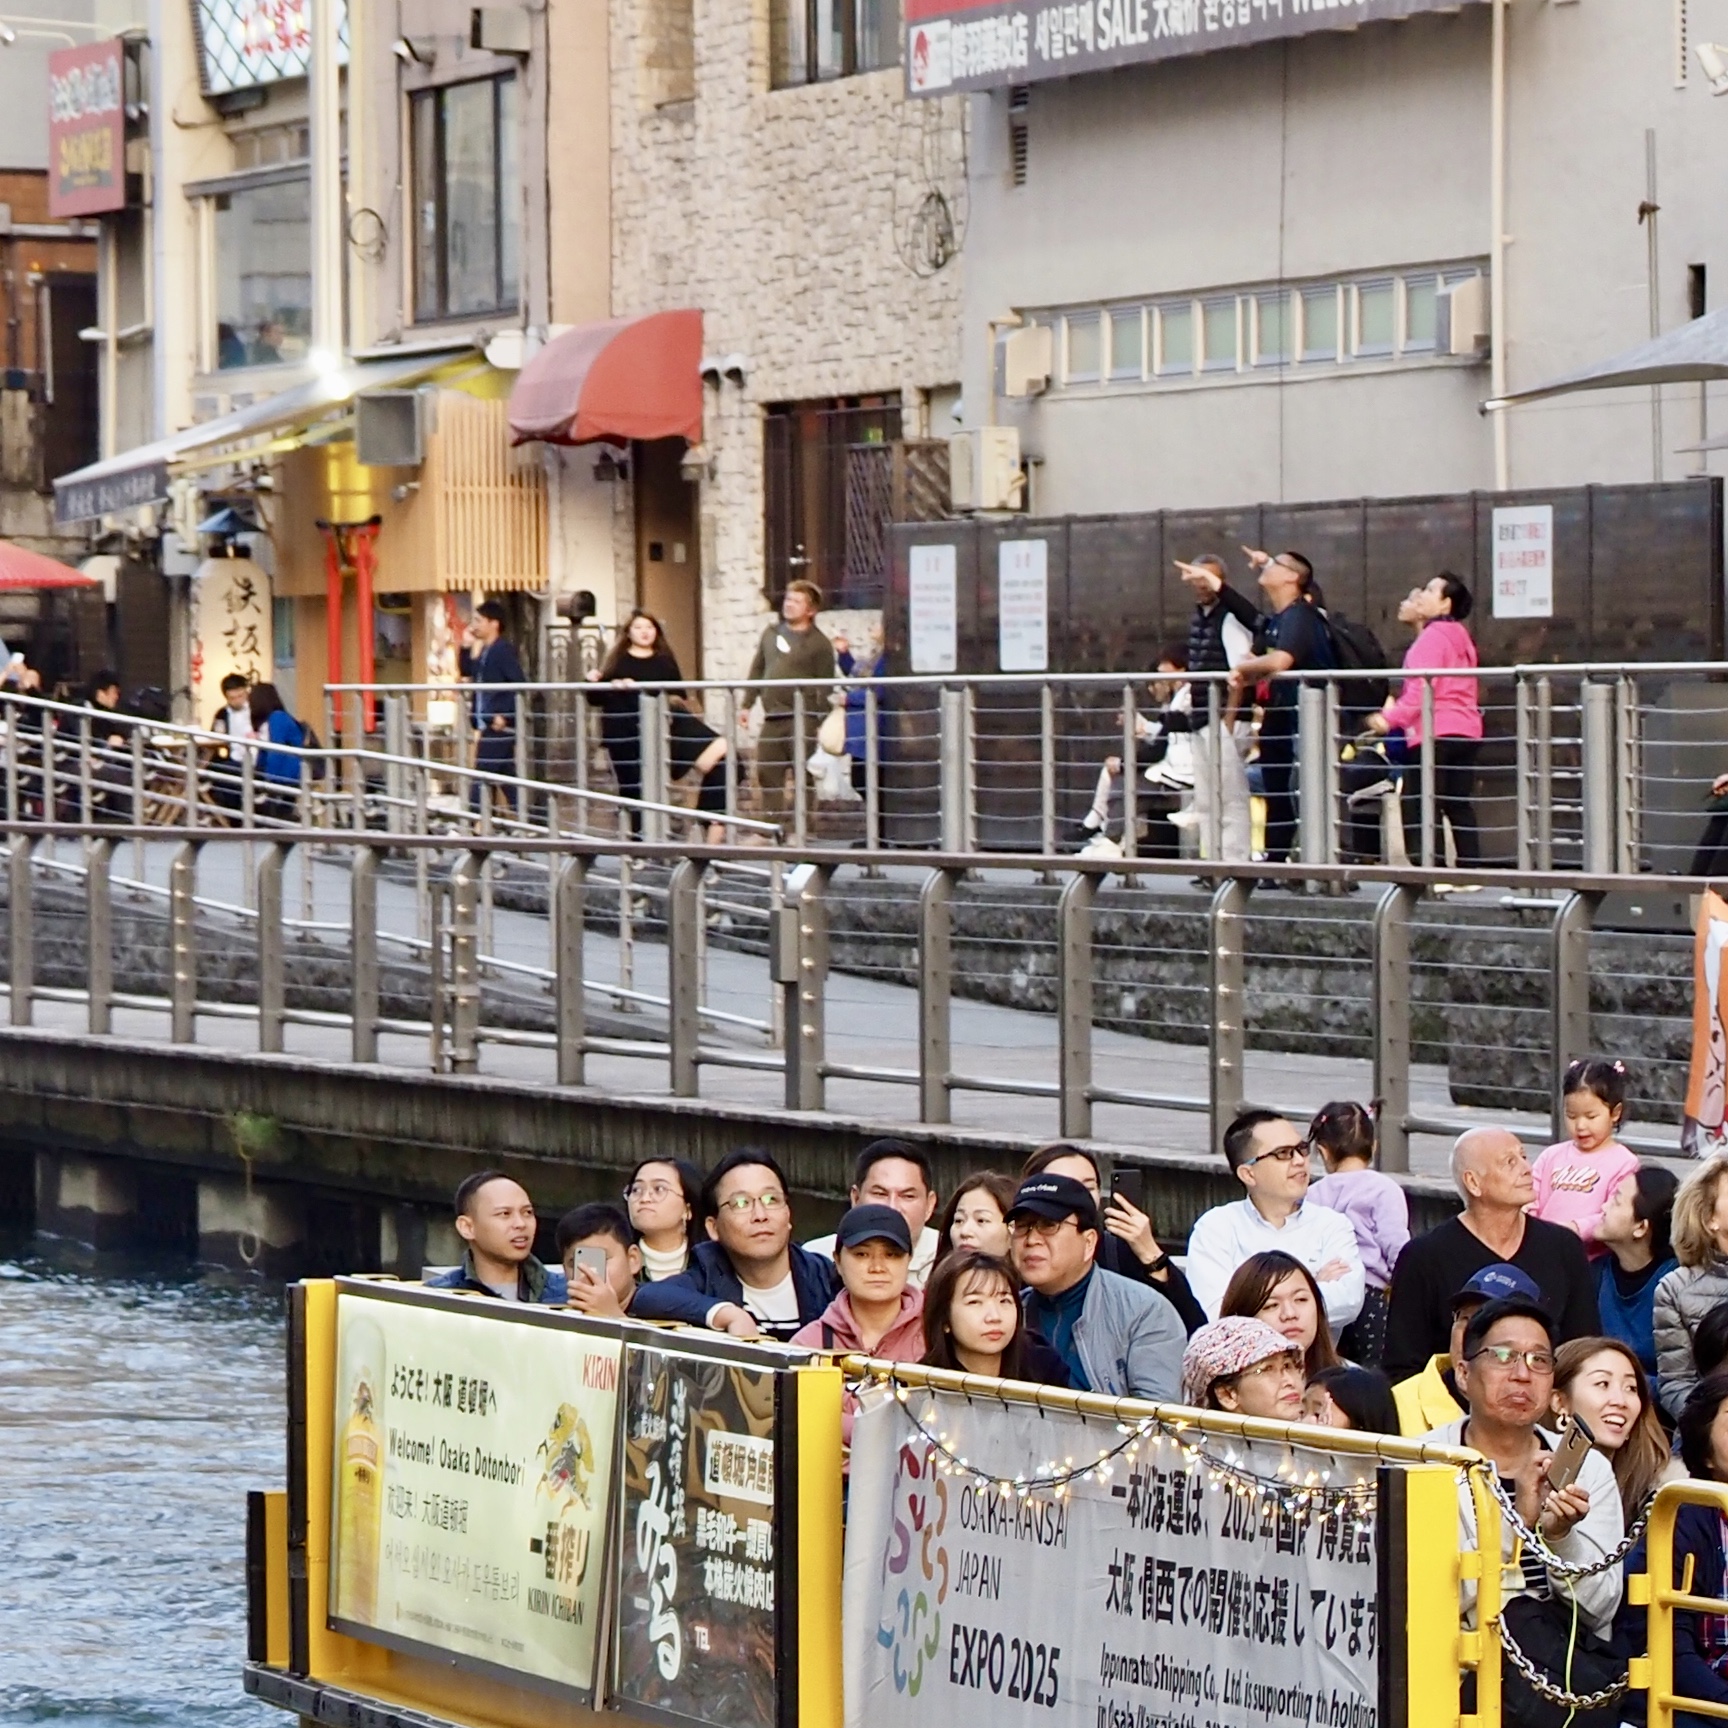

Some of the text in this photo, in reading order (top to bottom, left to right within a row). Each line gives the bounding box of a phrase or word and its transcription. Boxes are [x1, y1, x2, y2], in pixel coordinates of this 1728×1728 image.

[1098, 0, 1149, 50] SALE
[583, 1354, 618, 1392] KIRIN
[389, 1427, 526, 1487] Welcome! Osaka Dotonbori
[530, 1521, 590, 1587] 一番搾り
[955, 1549, 1001, 1601] JAPAN
[950, 1623, 1061, 1709] EXPO 2025
[1154, 1653, 1201, 1708] Shipping
[1244, 1671, 1252, 1709] is
